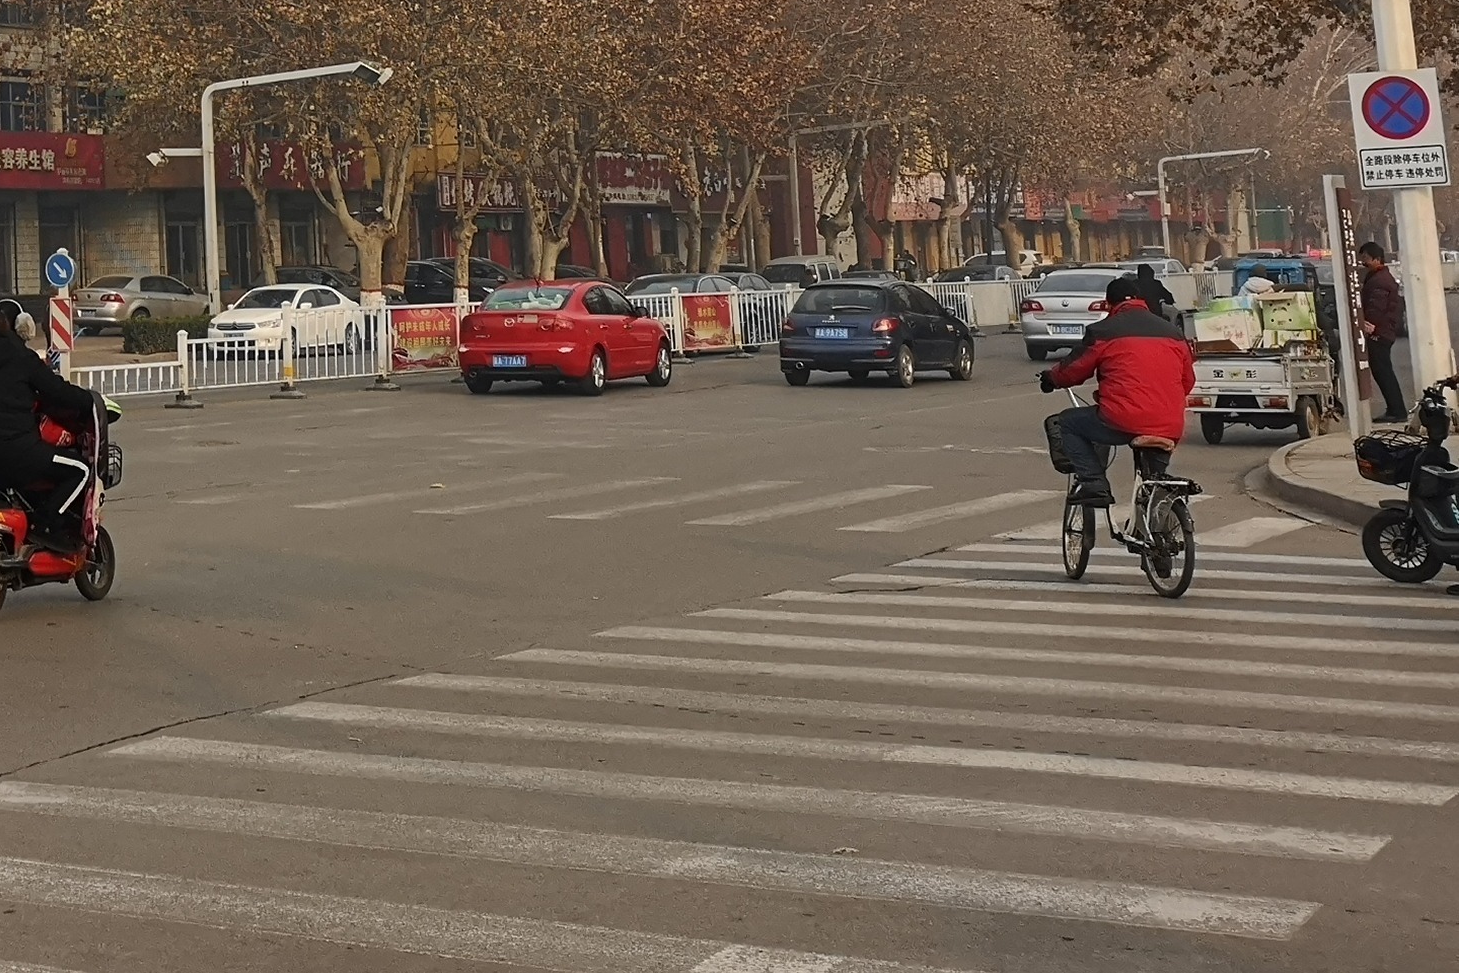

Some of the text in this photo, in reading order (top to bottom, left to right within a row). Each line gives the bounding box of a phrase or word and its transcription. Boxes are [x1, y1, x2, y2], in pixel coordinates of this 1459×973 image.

[1365, 152, 1440, 167] 全路段除停车位外
[1366, 166, 1444, 181] 禁止停车 违停处罚
